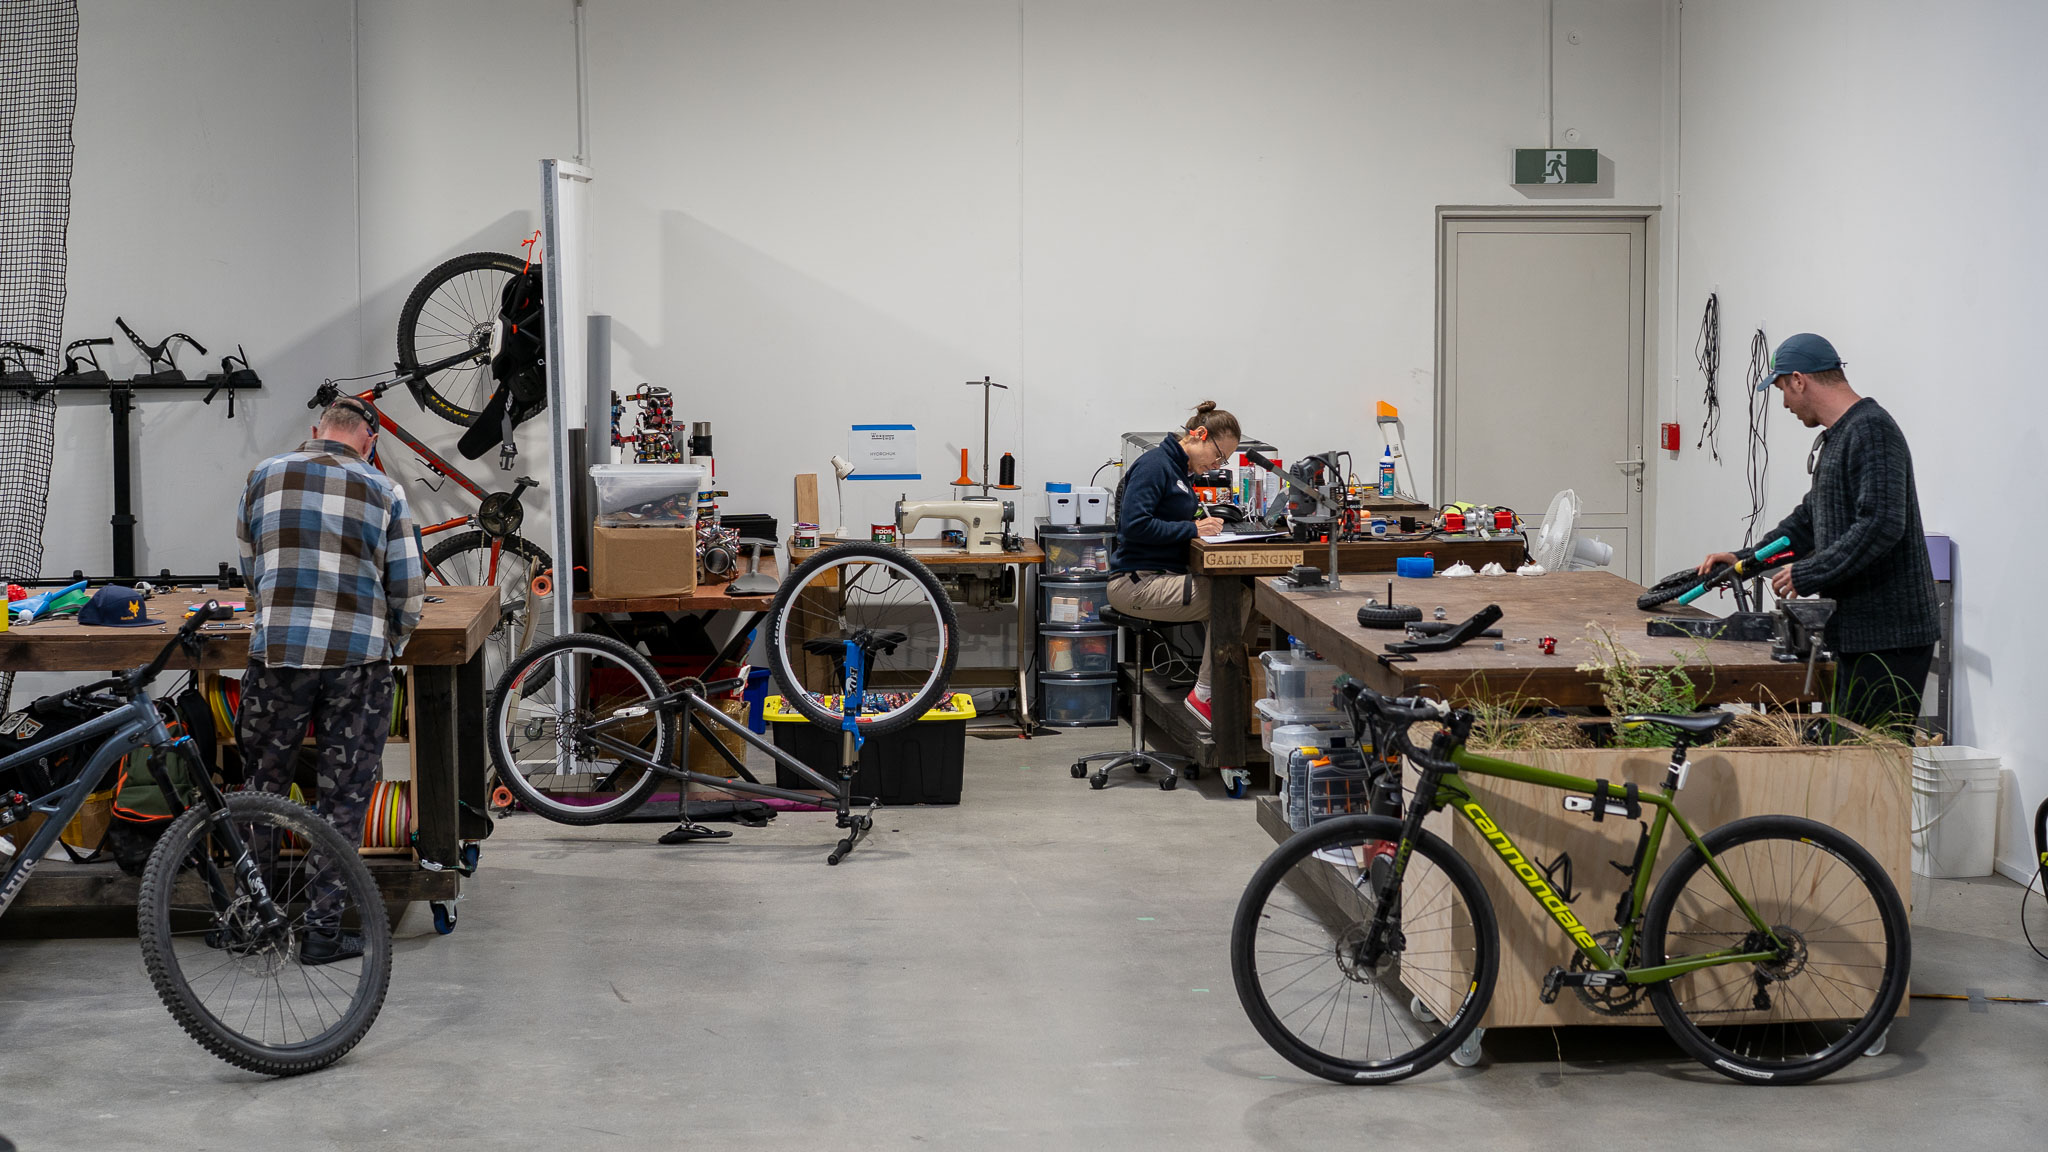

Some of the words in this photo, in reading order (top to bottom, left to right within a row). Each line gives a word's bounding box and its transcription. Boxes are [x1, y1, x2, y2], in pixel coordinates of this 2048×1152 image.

[1205, 553, 1247, 566] GALIN
[1250, 552, 1302, 566] ENGINE
[774, 607, 785, 646] KENDA
[1463, 803, 1597, 949] cannondale
